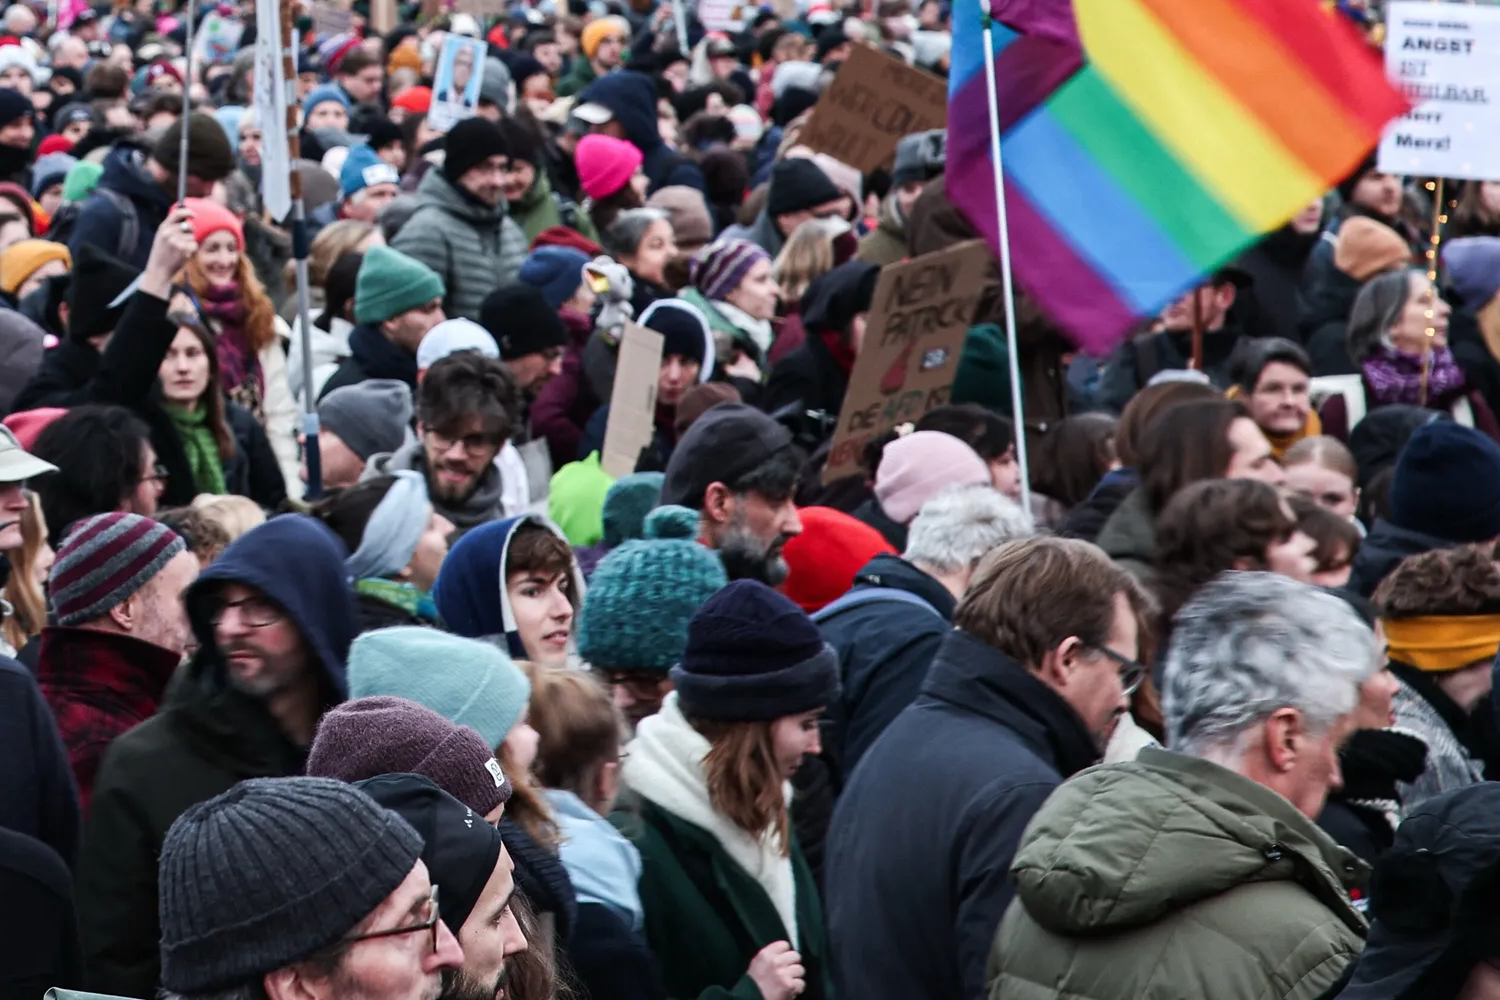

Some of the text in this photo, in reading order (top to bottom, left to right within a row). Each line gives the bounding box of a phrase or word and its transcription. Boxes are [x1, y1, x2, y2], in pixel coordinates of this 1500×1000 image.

[1402, 36, 1474, 54] ANGST
[1400, 60, 1429, 76] IST
[1395, 132, 1451, 150] Merz!
